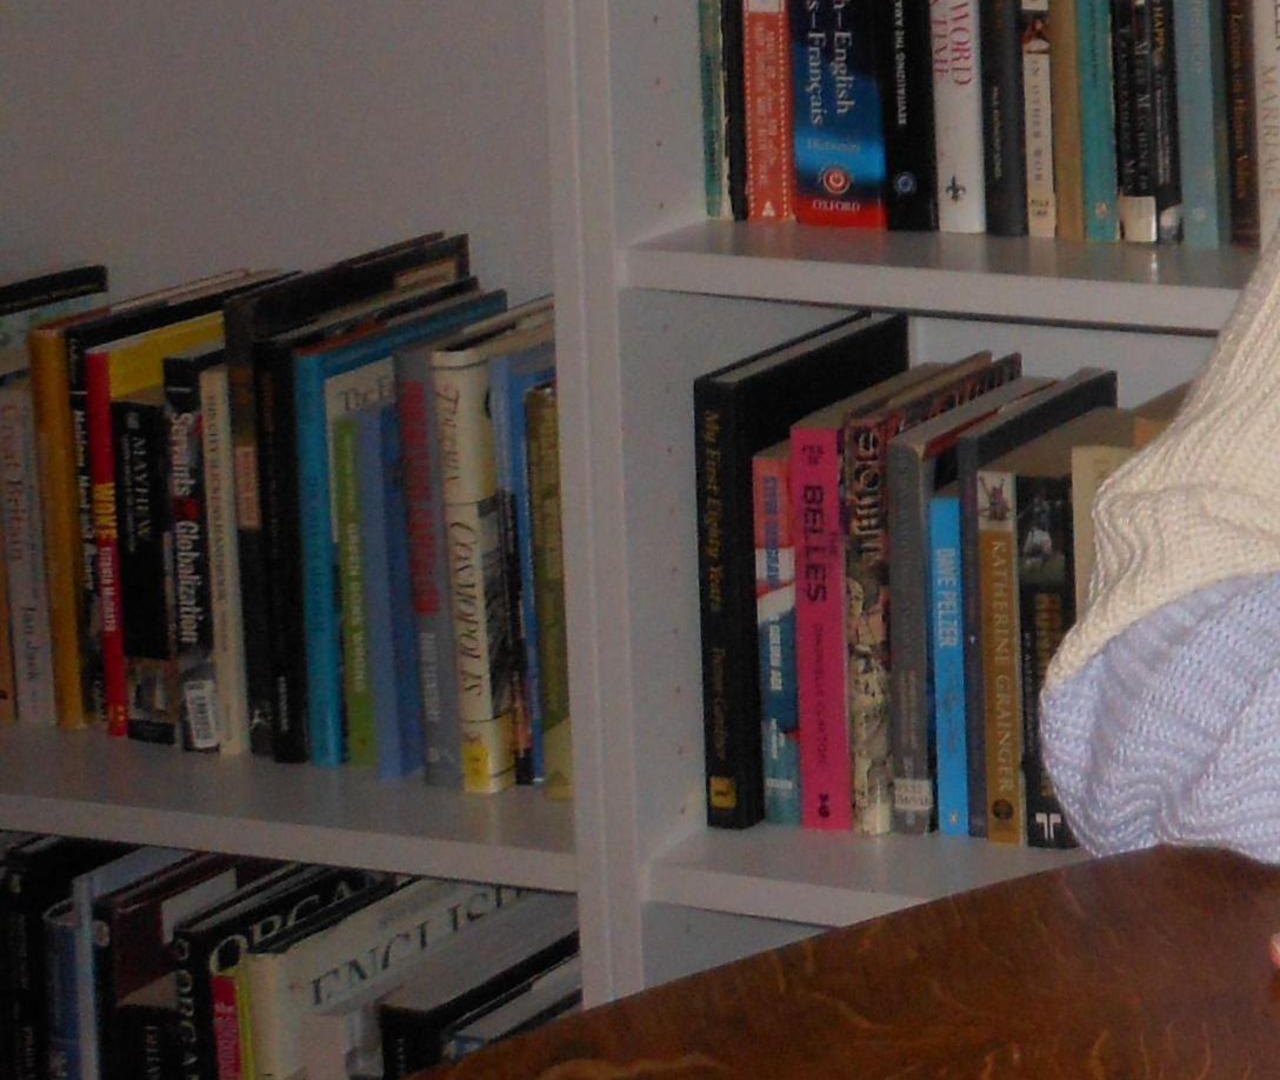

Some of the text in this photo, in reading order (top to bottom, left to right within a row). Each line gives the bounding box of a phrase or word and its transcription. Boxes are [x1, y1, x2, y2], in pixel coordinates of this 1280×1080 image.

[134, 436, 155, 539] MAYHEW
[170, 411, 203, 643] Servants Globalization
[803, 484, 827, 604] BELLES
[449, 520, 484, 698] COSMOPOLIS
[936, 547, 958, 649] DAVE PELZER
[992, 539, 1014, 793] KATHERINE GRAINGER
